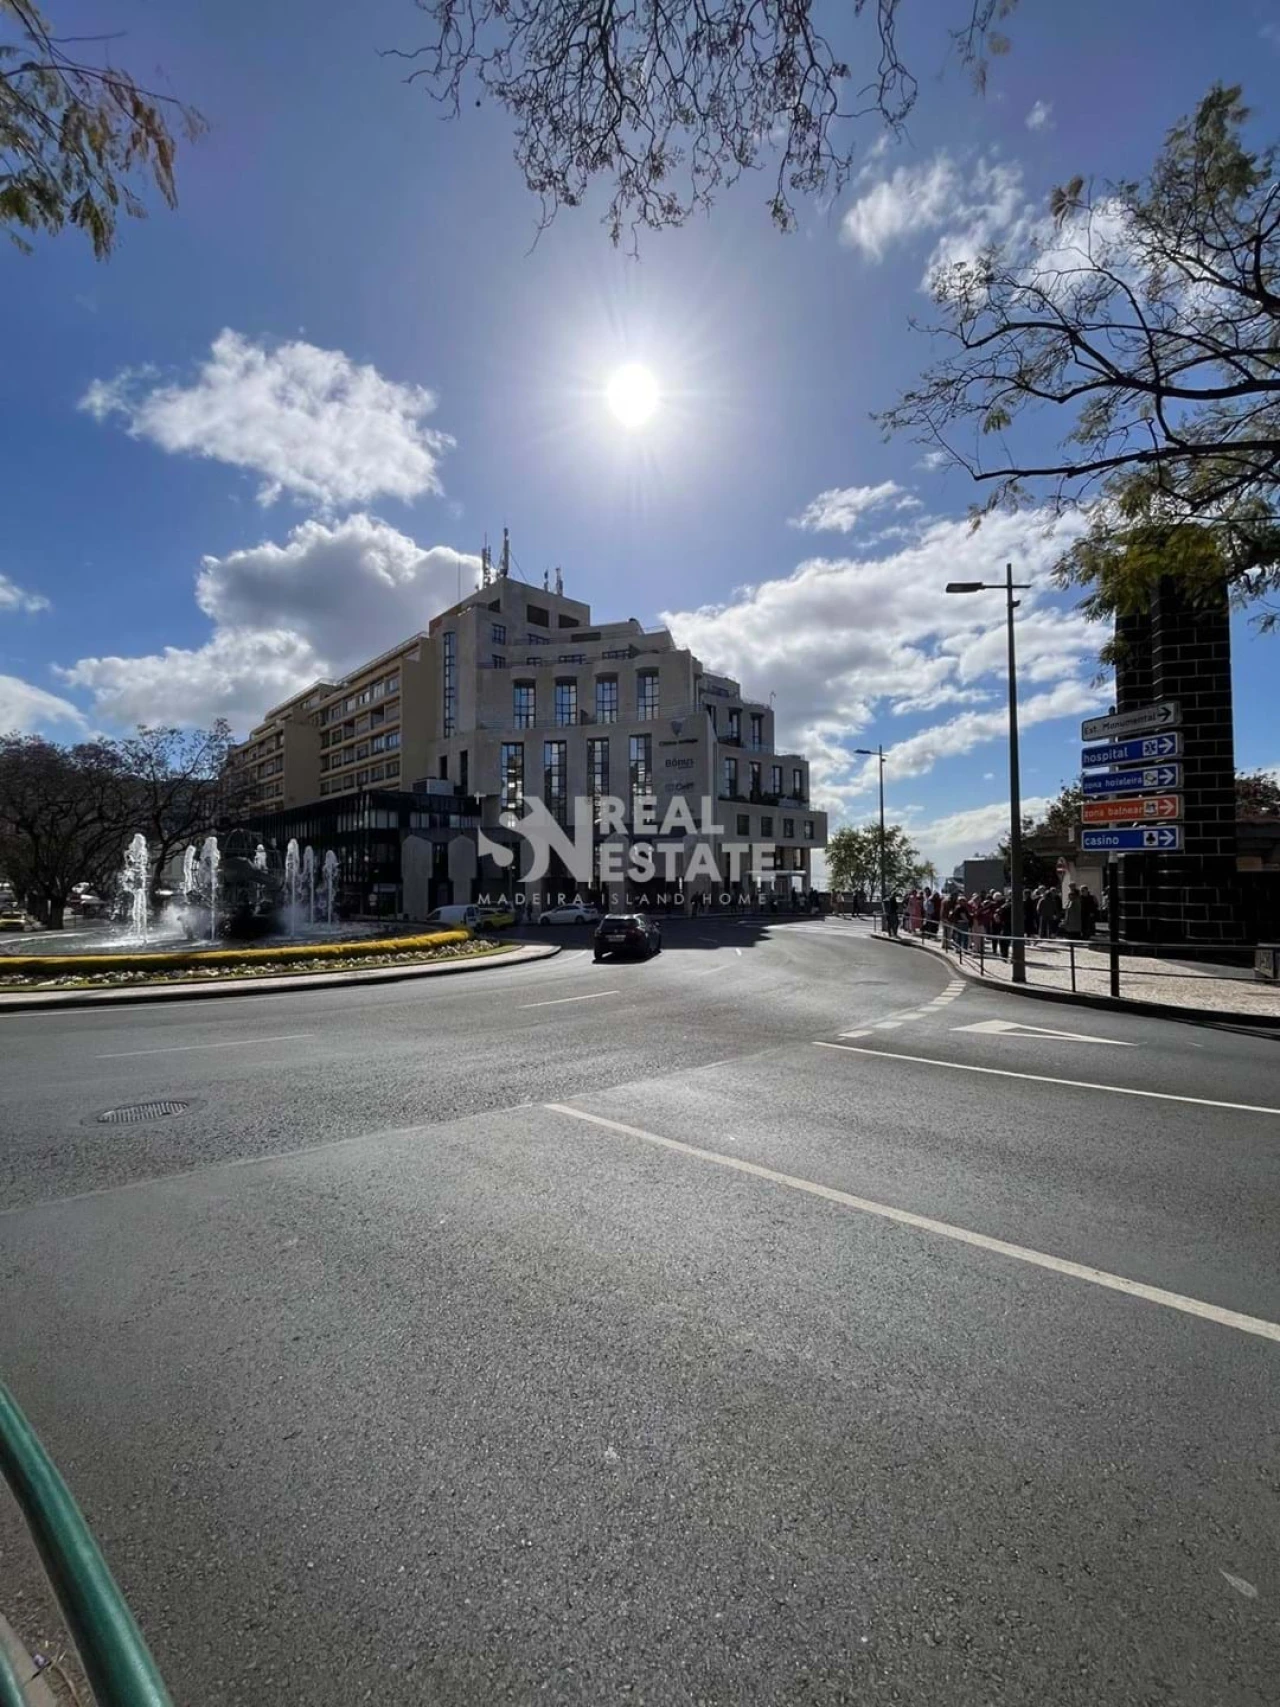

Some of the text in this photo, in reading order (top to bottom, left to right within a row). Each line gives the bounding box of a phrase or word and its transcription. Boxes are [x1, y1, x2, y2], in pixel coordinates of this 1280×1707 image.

[1103, 712, 1157, 731] Monumental
[1083, 747, 1129, 765] hospital
[1084, 805, 1144, 818] zona balnear
[1084, 834, 1120, 846] casino
